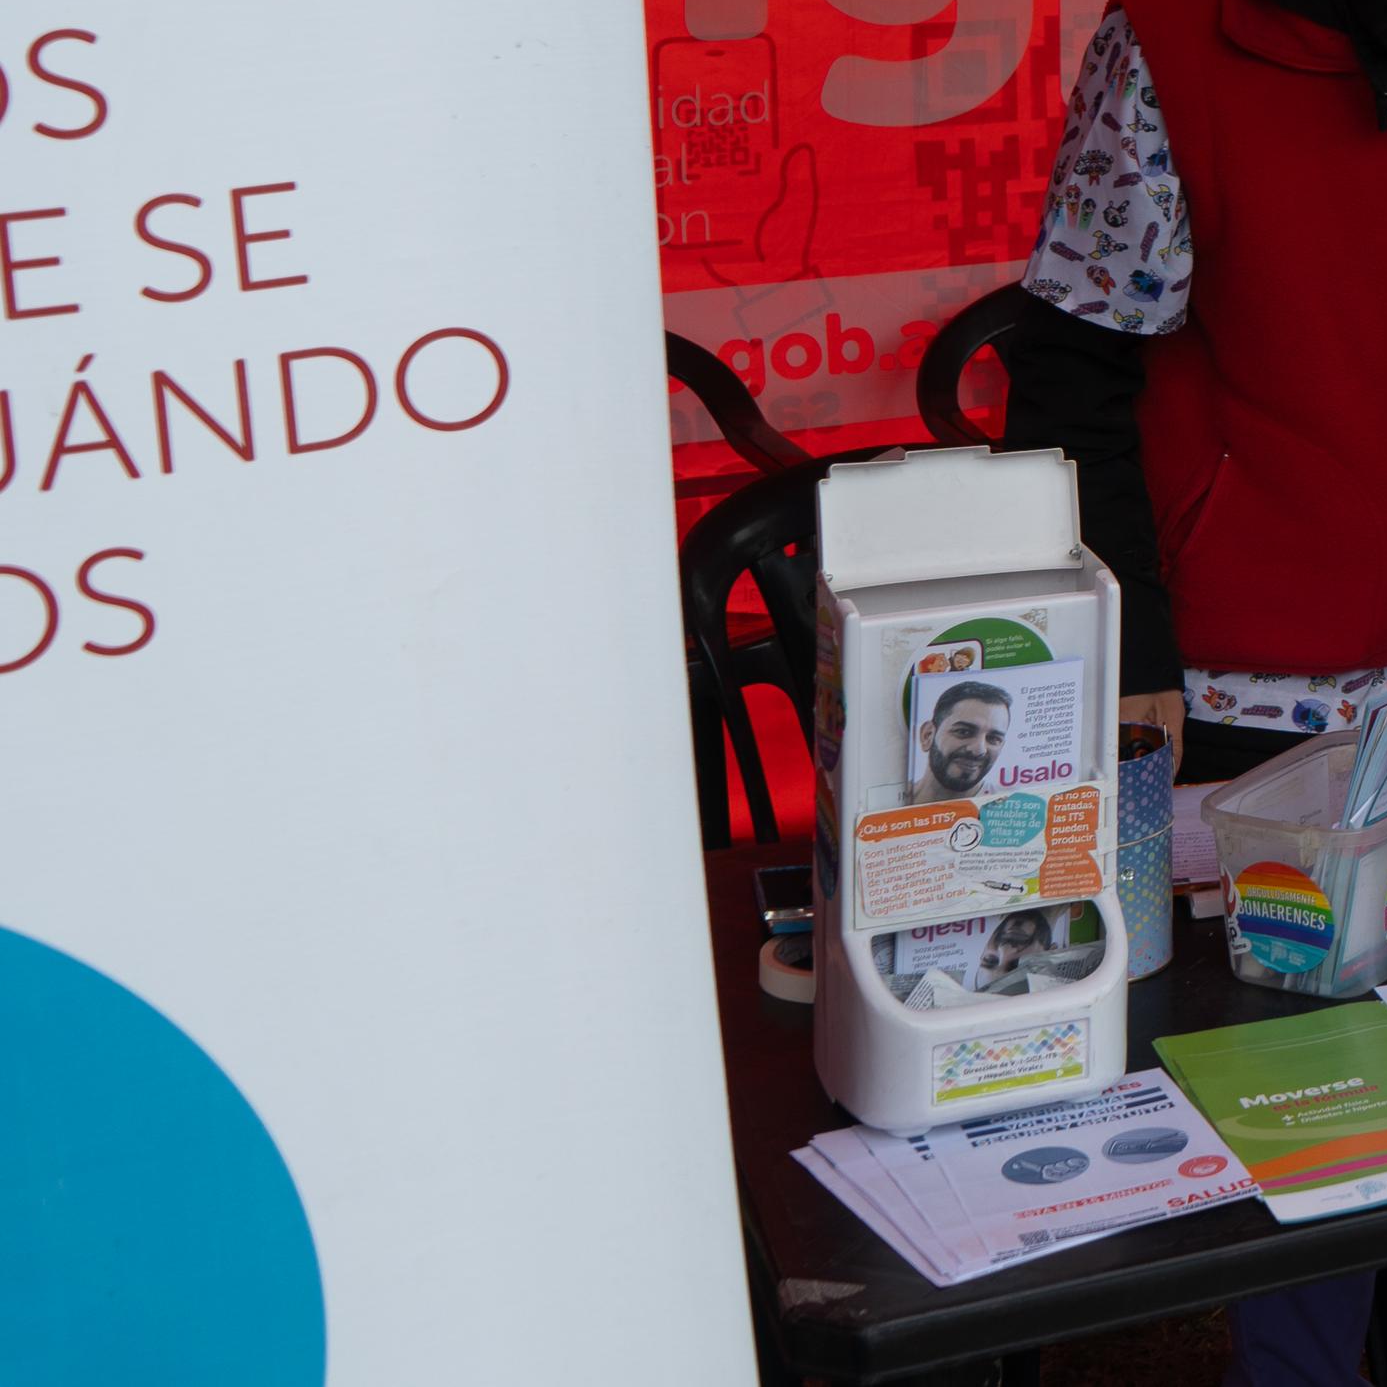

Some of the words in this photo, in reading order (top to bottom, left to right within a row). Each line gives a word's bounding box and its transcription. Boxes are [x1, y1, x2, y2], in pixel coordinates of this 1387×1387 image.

[0, 28, 109, 141] S
[134, 180, 309, 303] SE
[0, 326, 509, 494] ÁNDO
[999, 760, 1074, 788] Usalo
[1080, 789, 1100, 799] son
[1022, 801, 1040, 810] son
[1054, 802, 1096, 813] tratadas,
[859, 822, 889, 838] ¿Qué
[890, 821, 912, 831] son
[914, 817, 930, 827] las
[932, 811, 957, 825] ITS?
[987, 819, 1026, 829] muchas
[1028, 819, 1041, 828] de
[1052, 813, 1067, 823] las
[1068, 812, 1085, 822] ITS
[1052, 823, 1089, 836] pueden
[864, 850, 884, 860] Son
[887, 837, 945, 854] infecciones
[888, 849, 926, 864] pueden
[883, 873, 903, 884] una
[905, 865, 946, 881] persona
[892, 876, 932, 893] durante
[935, 872, 954, 882] una
[870, 890, 912, 907] relación
[914, 883, 945, 896] sexual
[912, 895, 935, 907] anal
[1238, 900, 1326, 931] BONAERENSES
[1239, 1077, 1365, 1110] Moverse
[1313, 1084, 1379, 1104] fórmula
[1006, 1103, 1128, 1131] VOLUNTARIO
[1166, 1176, 1257, 1209] SALUD
